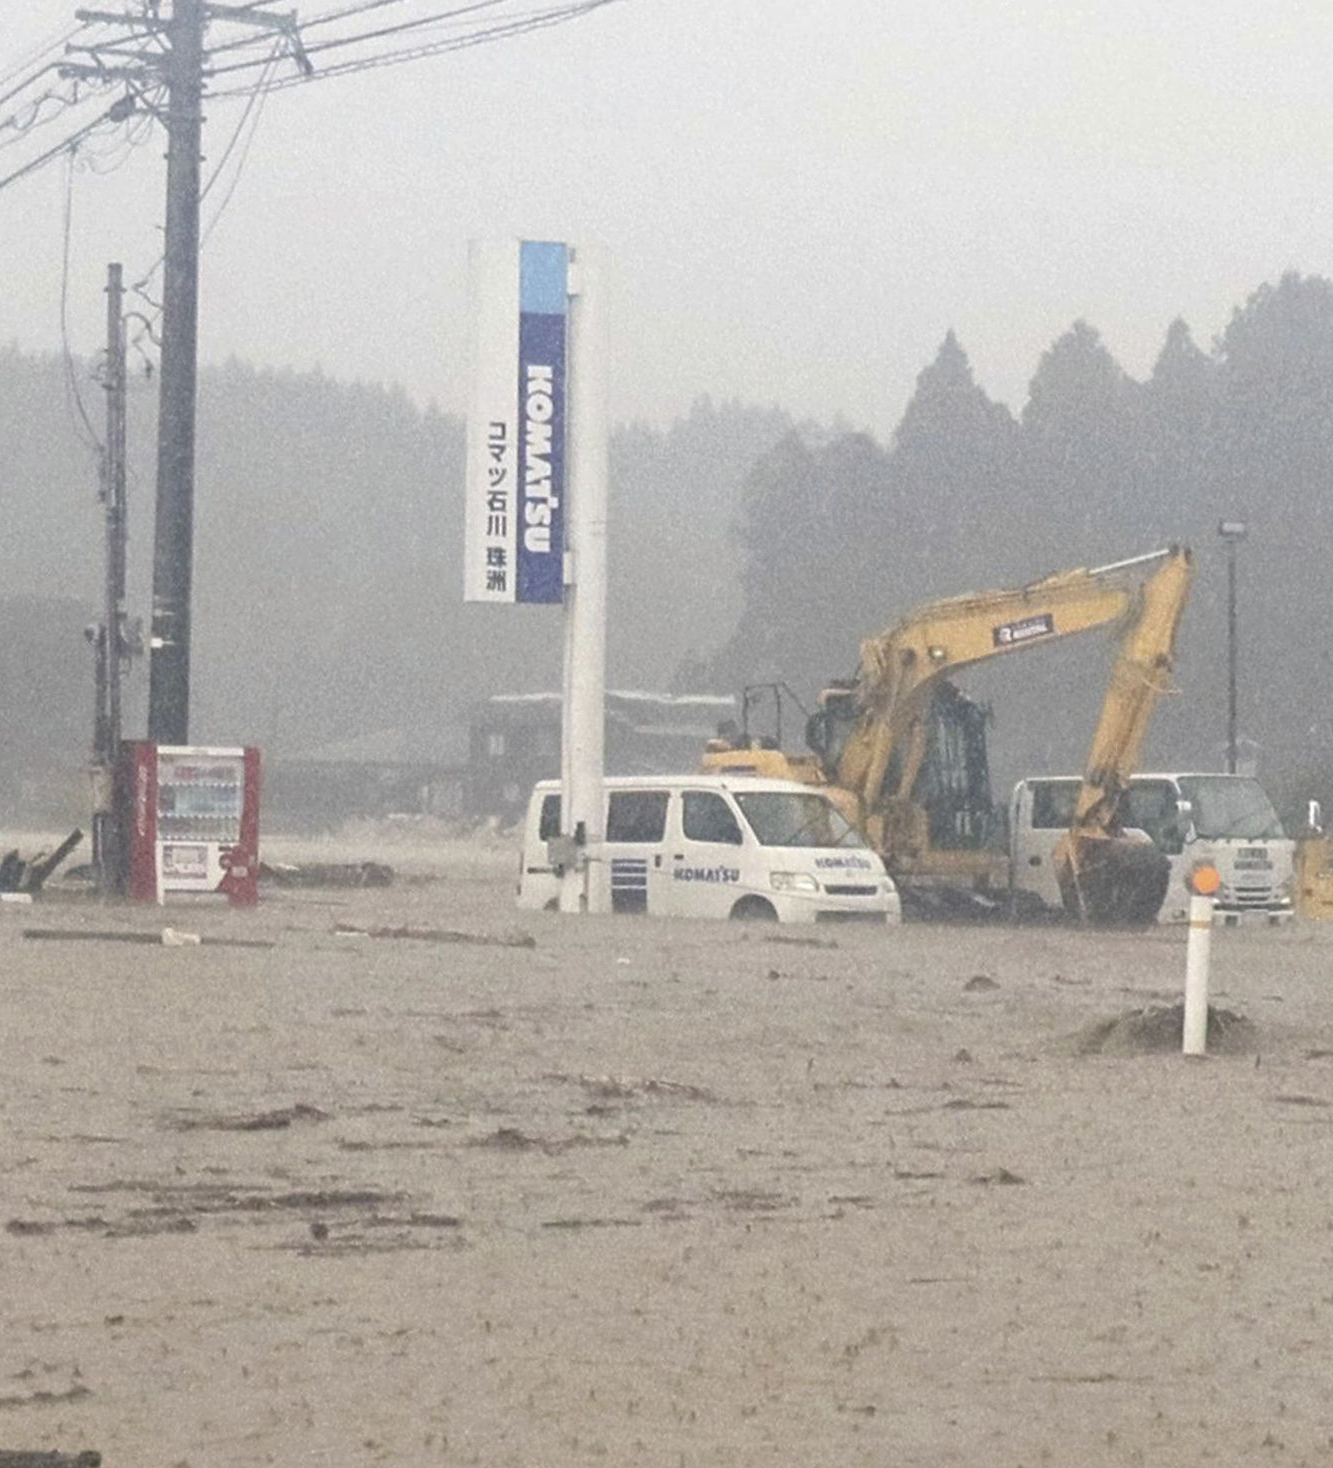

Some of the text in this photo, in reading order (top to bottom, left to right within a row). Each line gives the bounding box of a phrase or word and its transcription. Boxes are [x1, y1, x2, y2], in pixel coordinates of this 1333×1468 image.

[524, 365, 559, 553] KOMATSU
[815, 854, 872, 869] KOMATSU
[673, 865, 740, 881] KOMATSU
